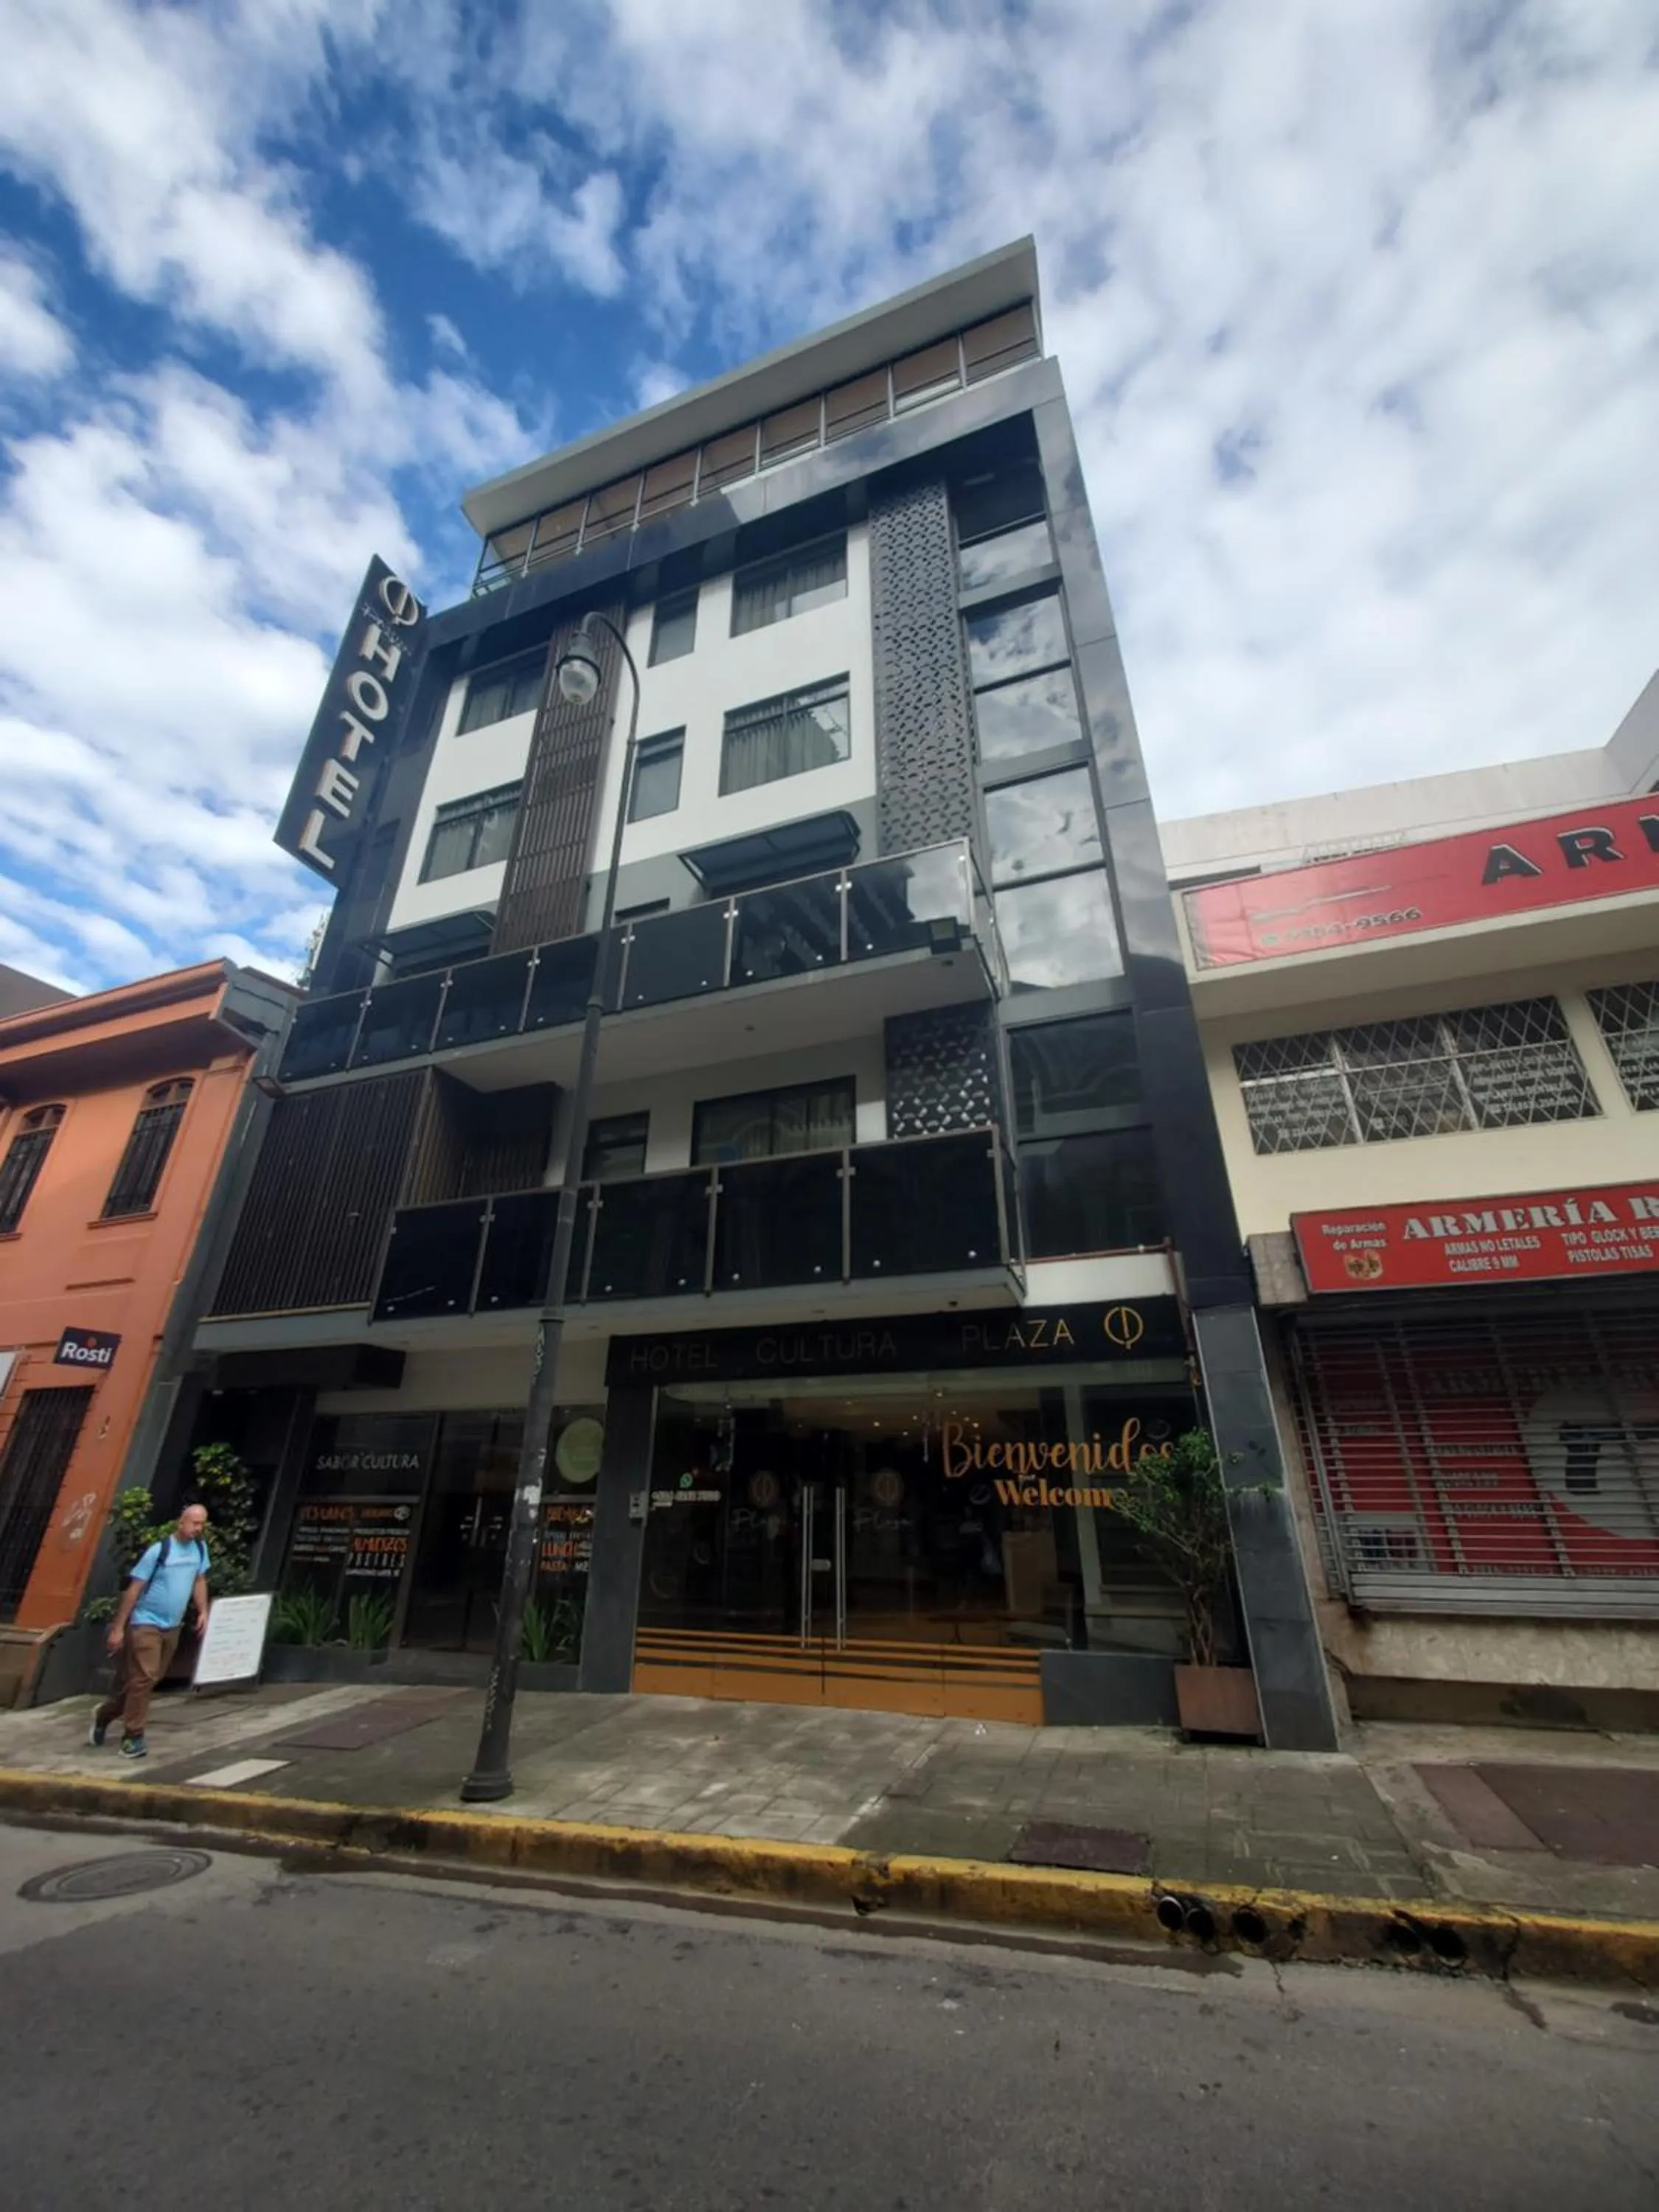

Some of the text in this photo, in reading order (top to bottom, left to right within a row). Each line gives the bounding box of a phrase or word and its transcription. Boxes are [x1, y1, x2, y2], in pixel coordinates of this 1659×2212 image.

[298, 623, 402, 869] HOTEL
[1403, 1198, 1619, 1239] ARMERÍA
[1445, 1236, 1541, 1256] ARMAS NO LETALES
[1561, 1231, 1587, 1245] TIPO
[1590, 1228, 1628, 1244] GLOCK
[1628, 1226, 1638, 1241] Y
[1449, 1256, 1492, 1273] CALIBRE
[1567, 1246, 1619, 1263] PISTOLAS
[61, 1341, 112, 1363] Rosti
[629, 1318, 1075, 1372] HOTEL CULTURA PLAZA
[993, 1478, 1121, 1509] Welcom
